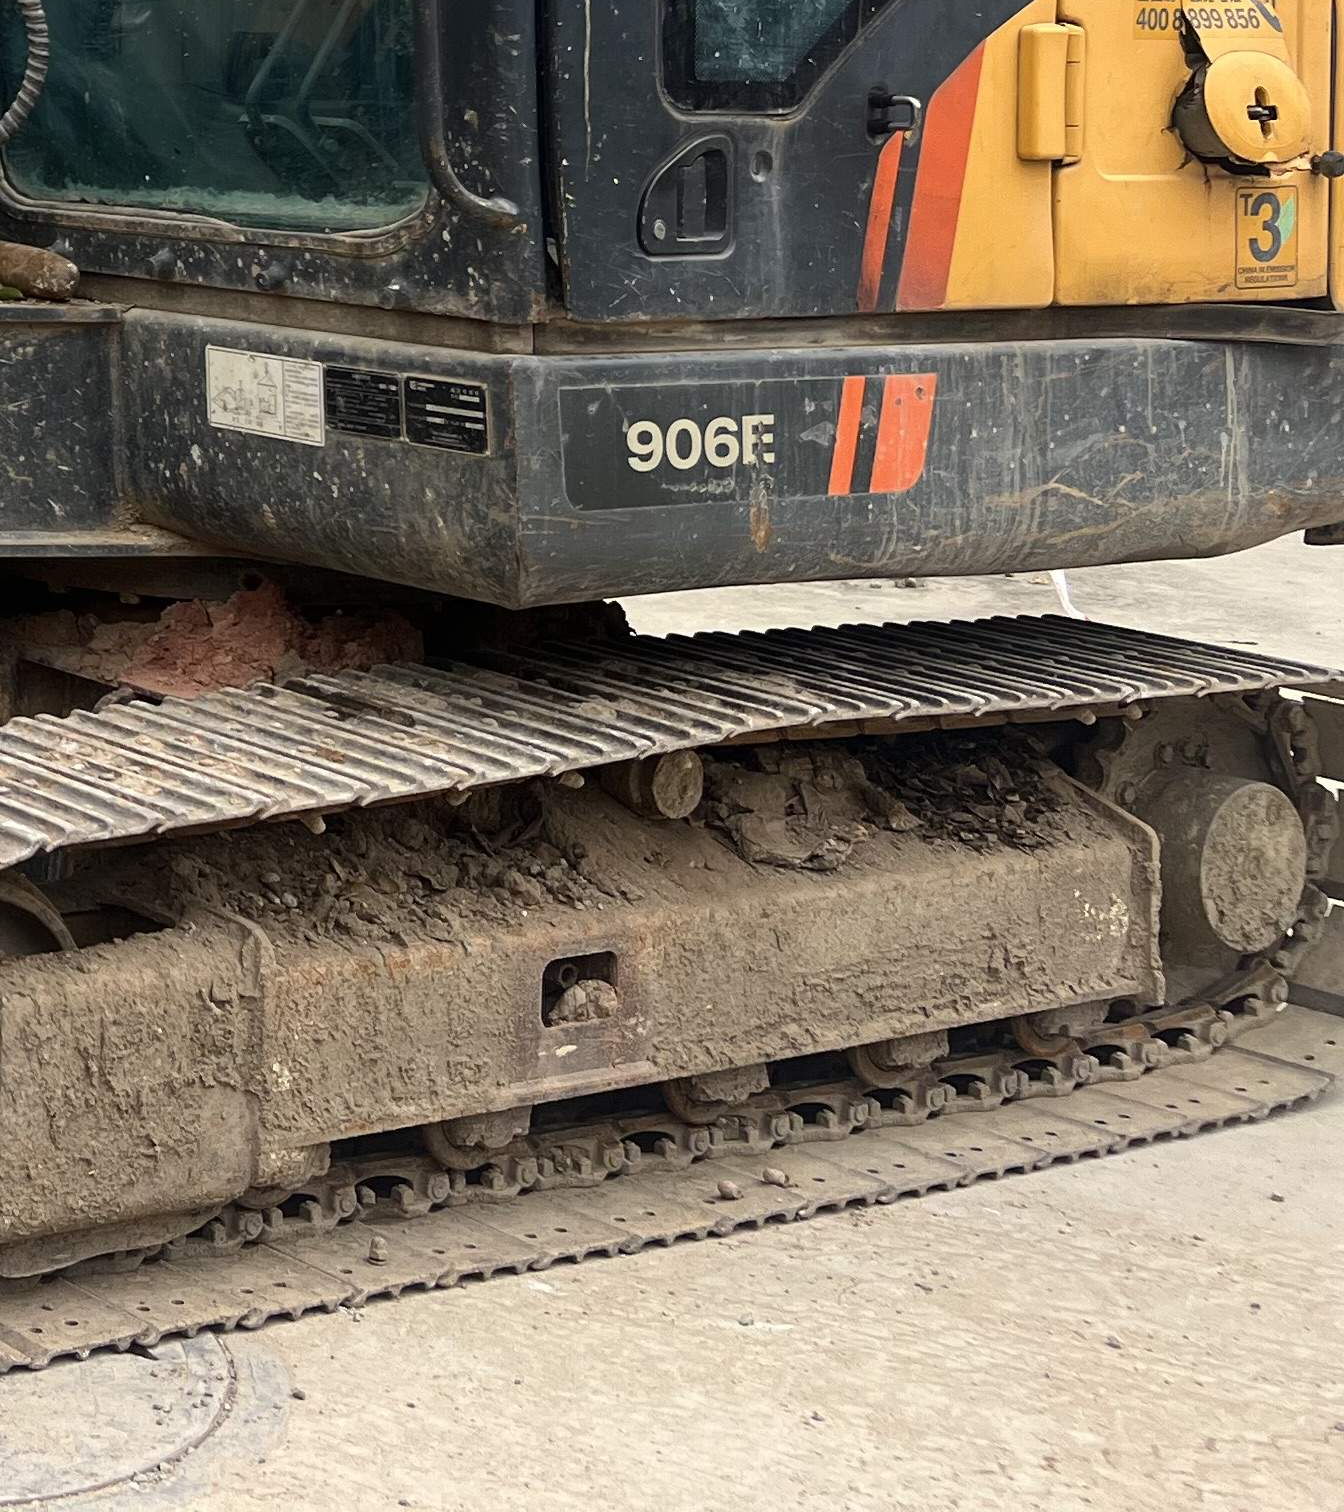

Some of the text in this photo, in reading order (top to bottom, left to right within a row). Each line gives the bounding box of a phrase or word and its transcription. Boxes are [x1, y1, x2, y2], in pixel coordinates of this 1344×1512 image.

[1136, 8, 1169, 31] 400
[1224, 8, 1260, 29] 856
[626, 413, 776, 473] 906E
